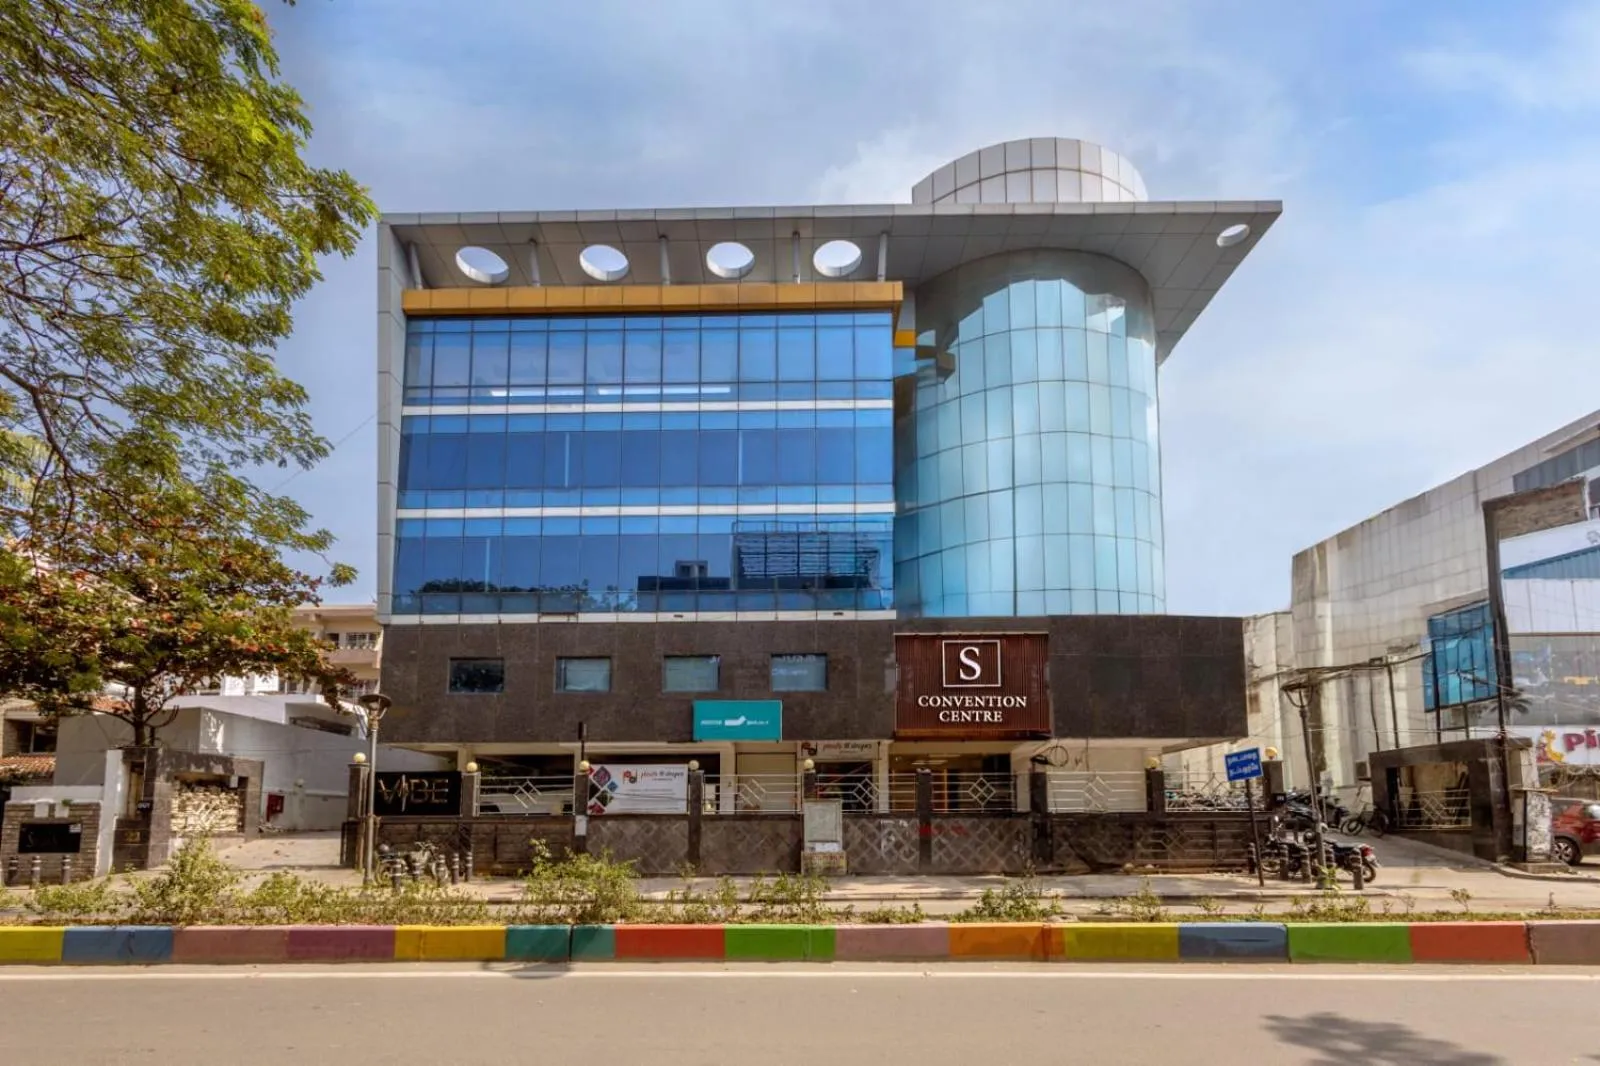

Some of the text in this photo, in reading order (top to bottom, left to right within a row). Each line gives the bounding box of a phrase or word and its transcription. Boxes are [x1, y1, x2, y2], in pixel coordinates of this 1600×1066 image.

[960, 646, 981, 680] S
[918, 695, 1027, 708] CONVENTION
[939, 710, 1003, 722] CENTRE
